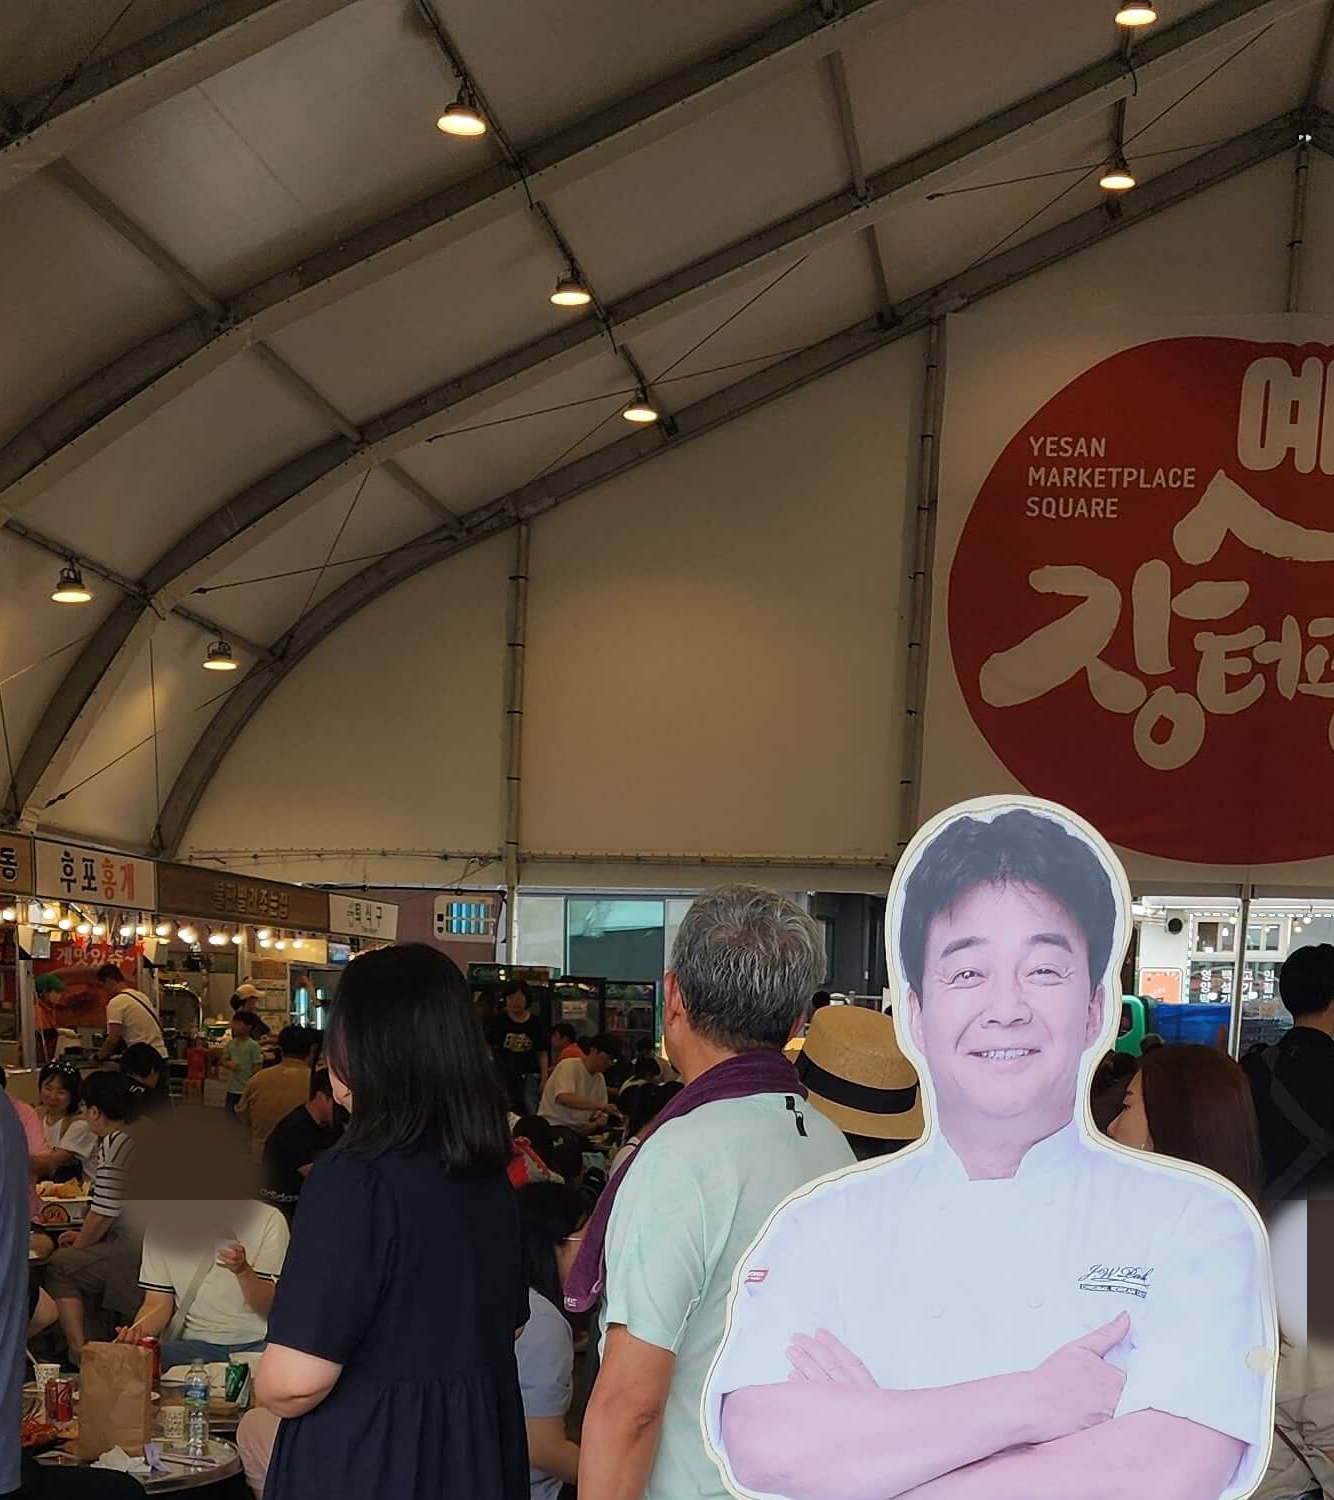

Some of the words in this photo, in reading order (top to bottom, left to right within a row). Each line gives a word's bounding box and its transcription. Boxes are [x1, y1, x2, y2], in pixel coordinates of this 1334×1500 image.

[1028, 436, 1106, 458] YESAN
[1027, 466, 1196, 489] MARKETPLACE
[1026, 496, 1118, 519] SQUARE
[60, 850, 135, 901] 후포홍게
